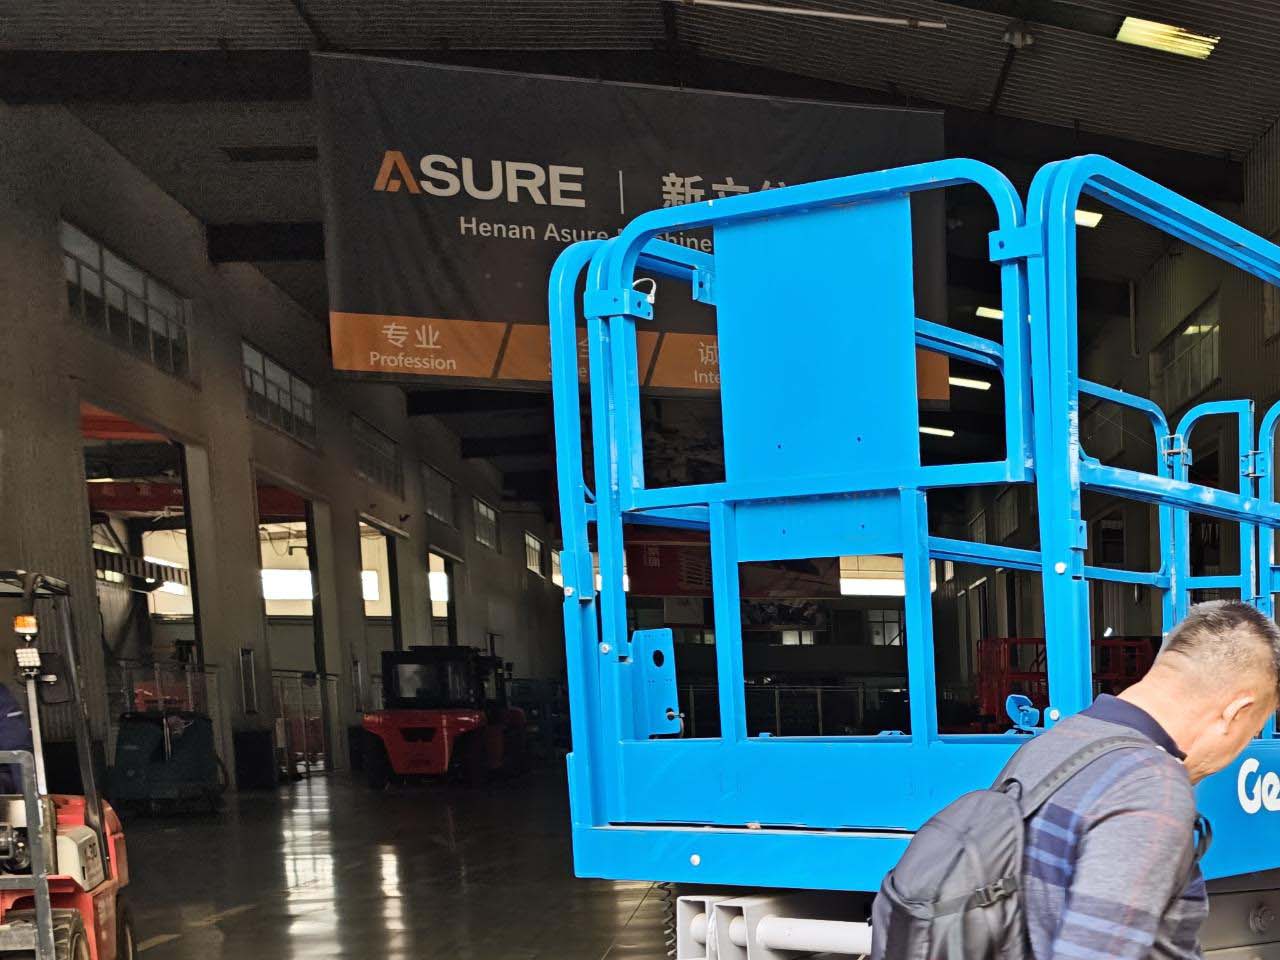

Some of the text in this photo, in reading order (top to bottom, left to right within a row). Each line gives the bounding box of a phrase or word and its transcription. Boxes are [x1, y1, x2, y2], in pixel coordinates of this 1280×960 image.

[373, 150, 586, 208] ASURE
[459, 215, 536, 241] Henan
[544, 222, 609, 243] Asure
[381, 322, 442, 350] 专业
[369, 351, 457, 371] Profession
